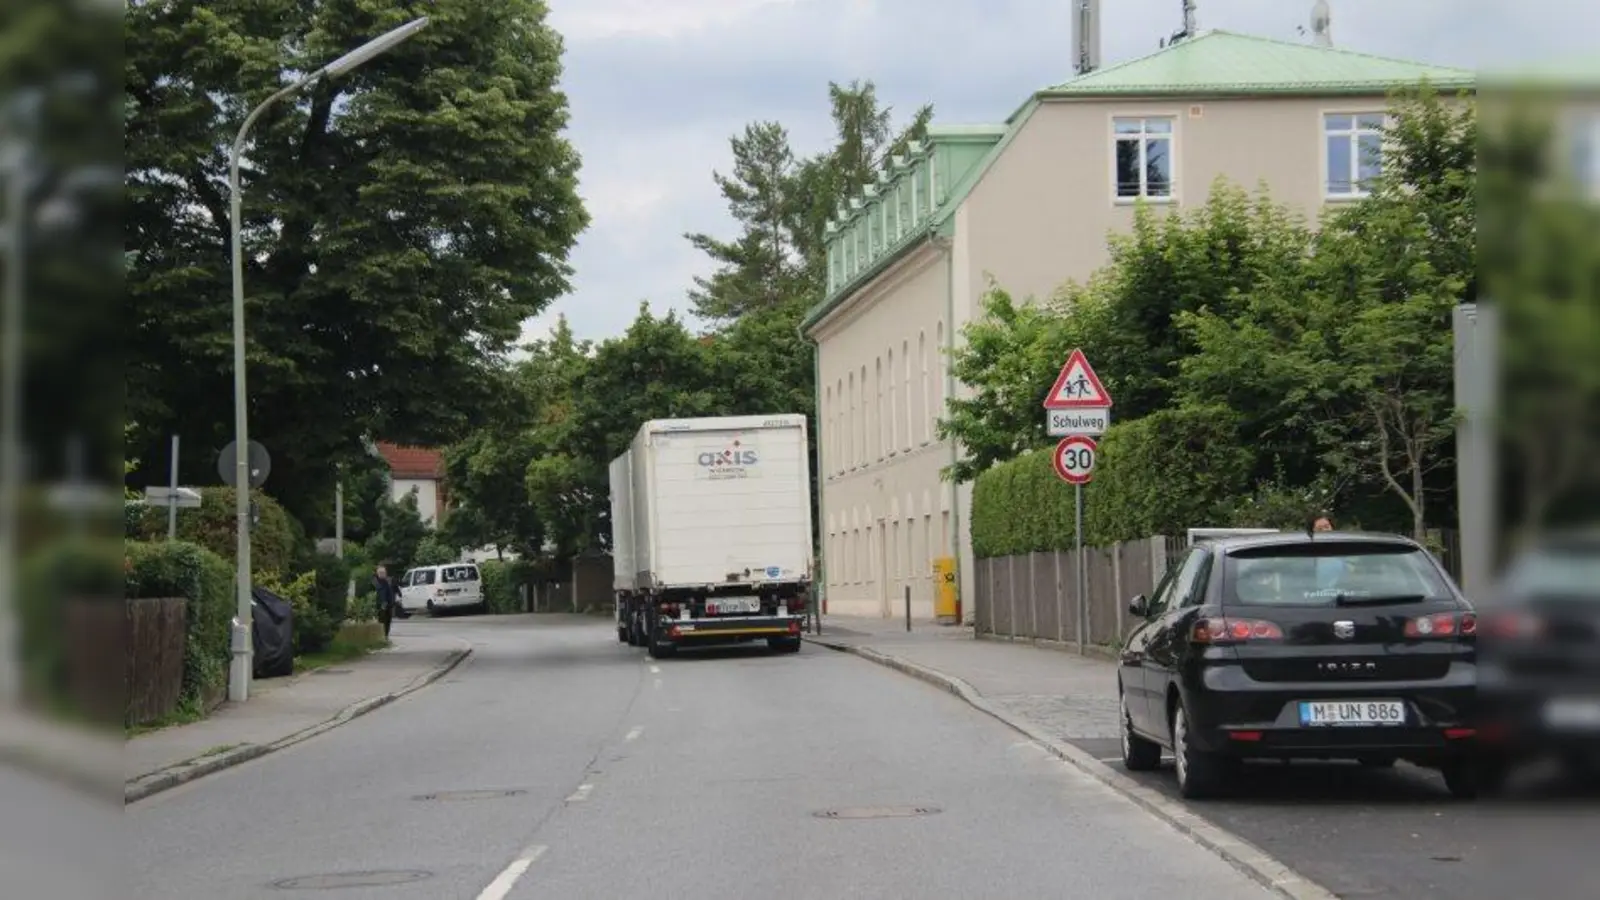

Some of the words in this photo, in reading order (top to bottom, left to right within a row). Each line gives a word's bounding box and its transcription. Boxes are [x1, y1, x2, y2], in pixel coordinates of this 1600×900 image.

[1053, 414, 1104, 430] Schulweg
[698, 440, 758, 467] axis
[1065, 448, 1091, 470] 30
[1314, 704, 1326, 720] M
[1339, 704, 1362, 720] UN
[1367, 703, 1399, 720] 886
